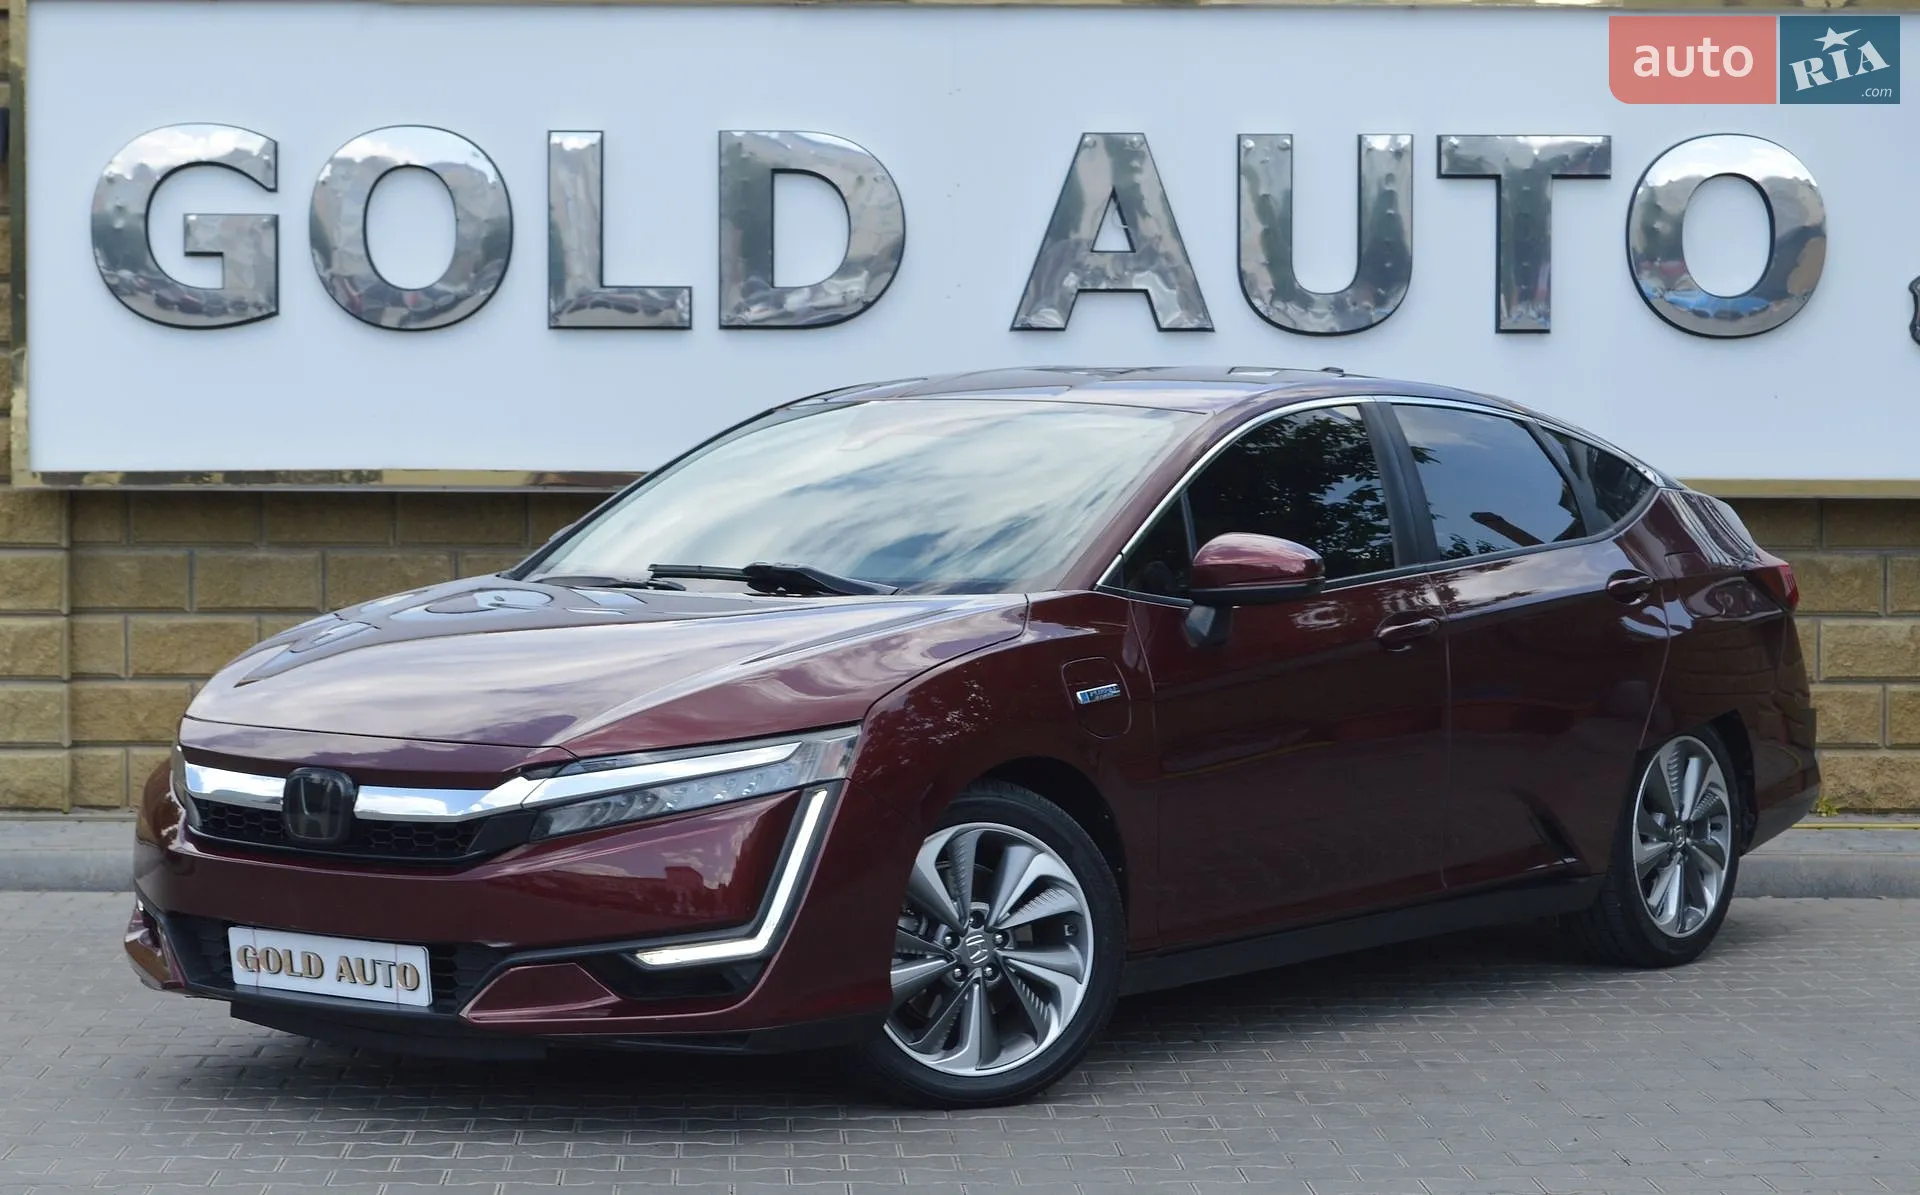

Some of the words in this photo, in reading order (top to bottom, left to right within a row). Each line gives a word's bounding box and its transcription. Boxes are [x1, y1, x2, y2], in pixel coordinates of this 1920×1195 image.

[91, 122, 906, 331] GOLD
[1010, 133, 1827, 339] AUTO
[236, 944, 325, 980] GOLD
[335, 955, 420, 992] AUTO
